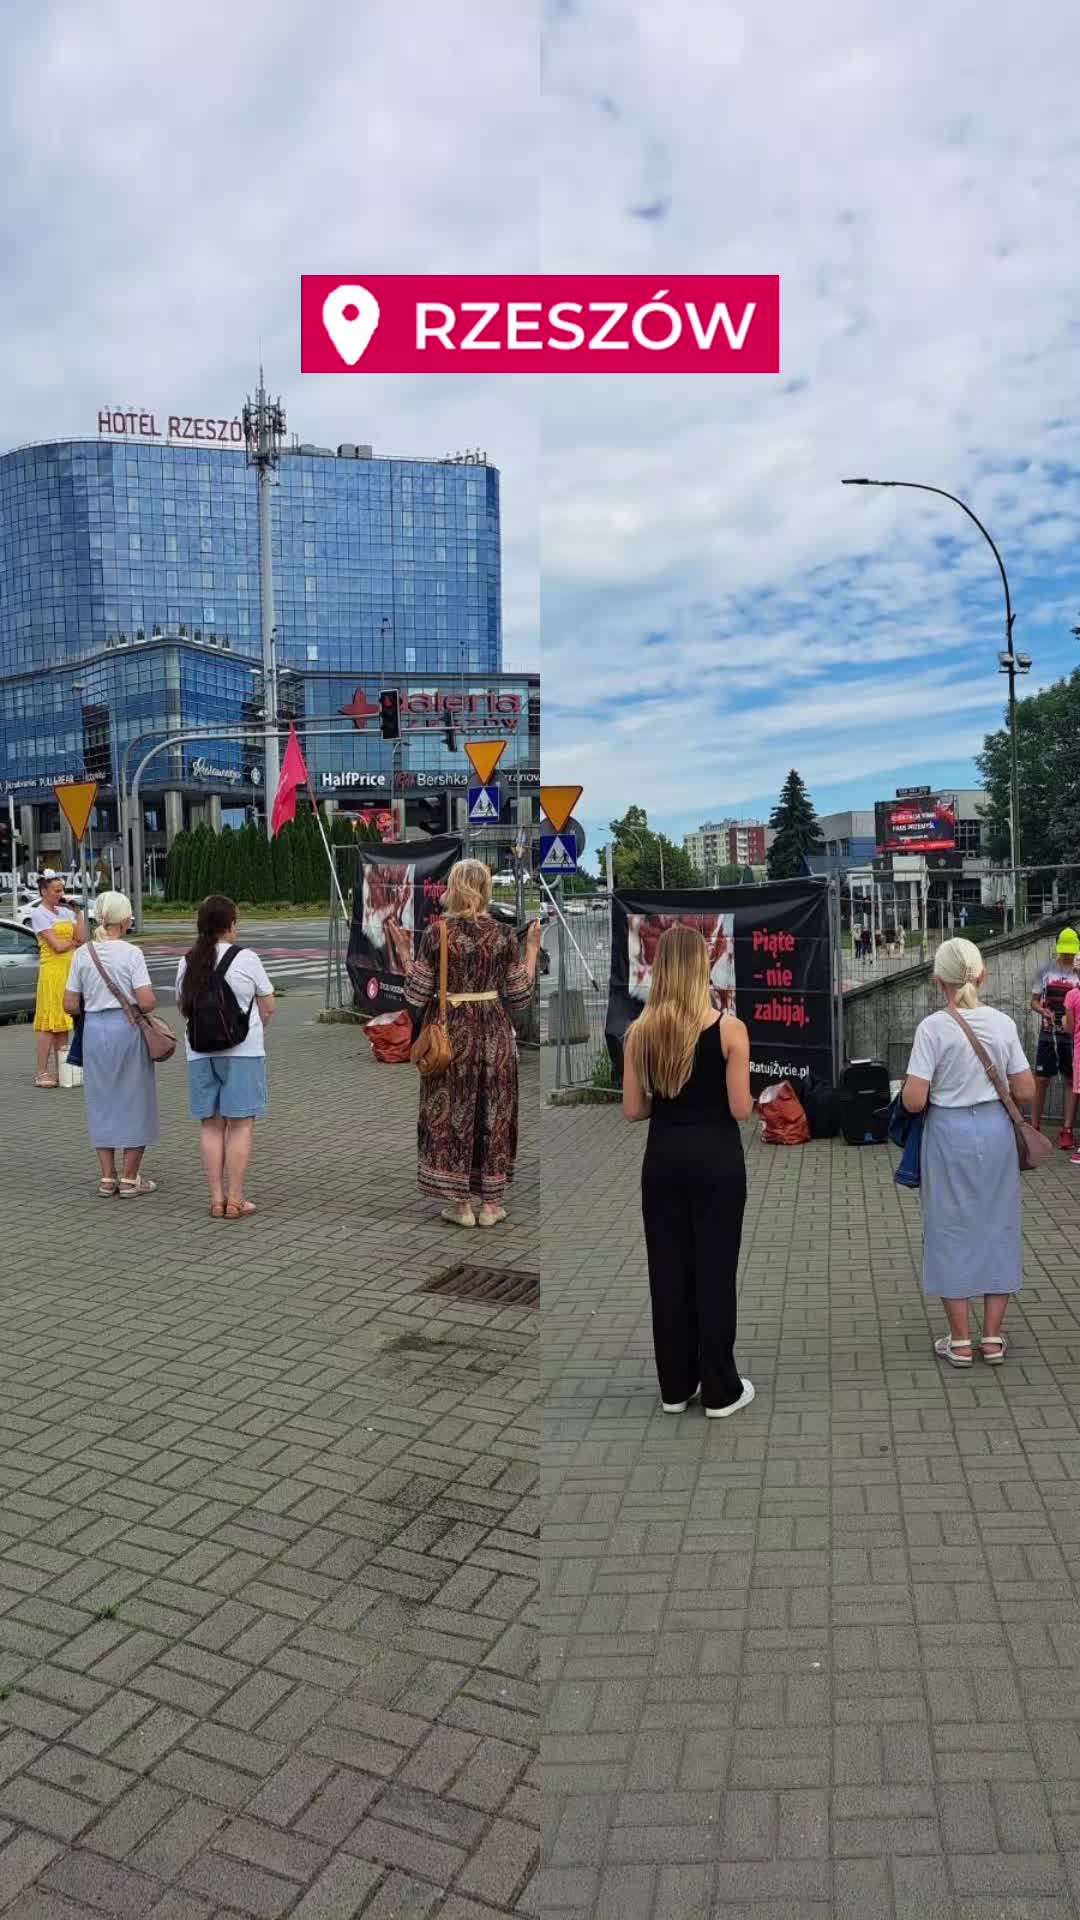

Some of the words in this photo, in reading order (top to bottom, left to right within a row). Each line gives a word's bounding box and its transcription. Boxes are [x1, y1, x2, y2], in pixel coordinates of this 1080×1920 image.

[98, 411, 162, 437] HOTEL
[401, 687, 521, 714] aleria
[322, 772, 386, 786] HalfPrice
[416, 773, 469, 786] Bershka
[752, 928, 796, 958] Piąte
[766, 962, 793, 988] nie
[753, 999, 810, 1027] zabijaj.
[749, 1060, 810, 1079] RatujŻycie.pl
